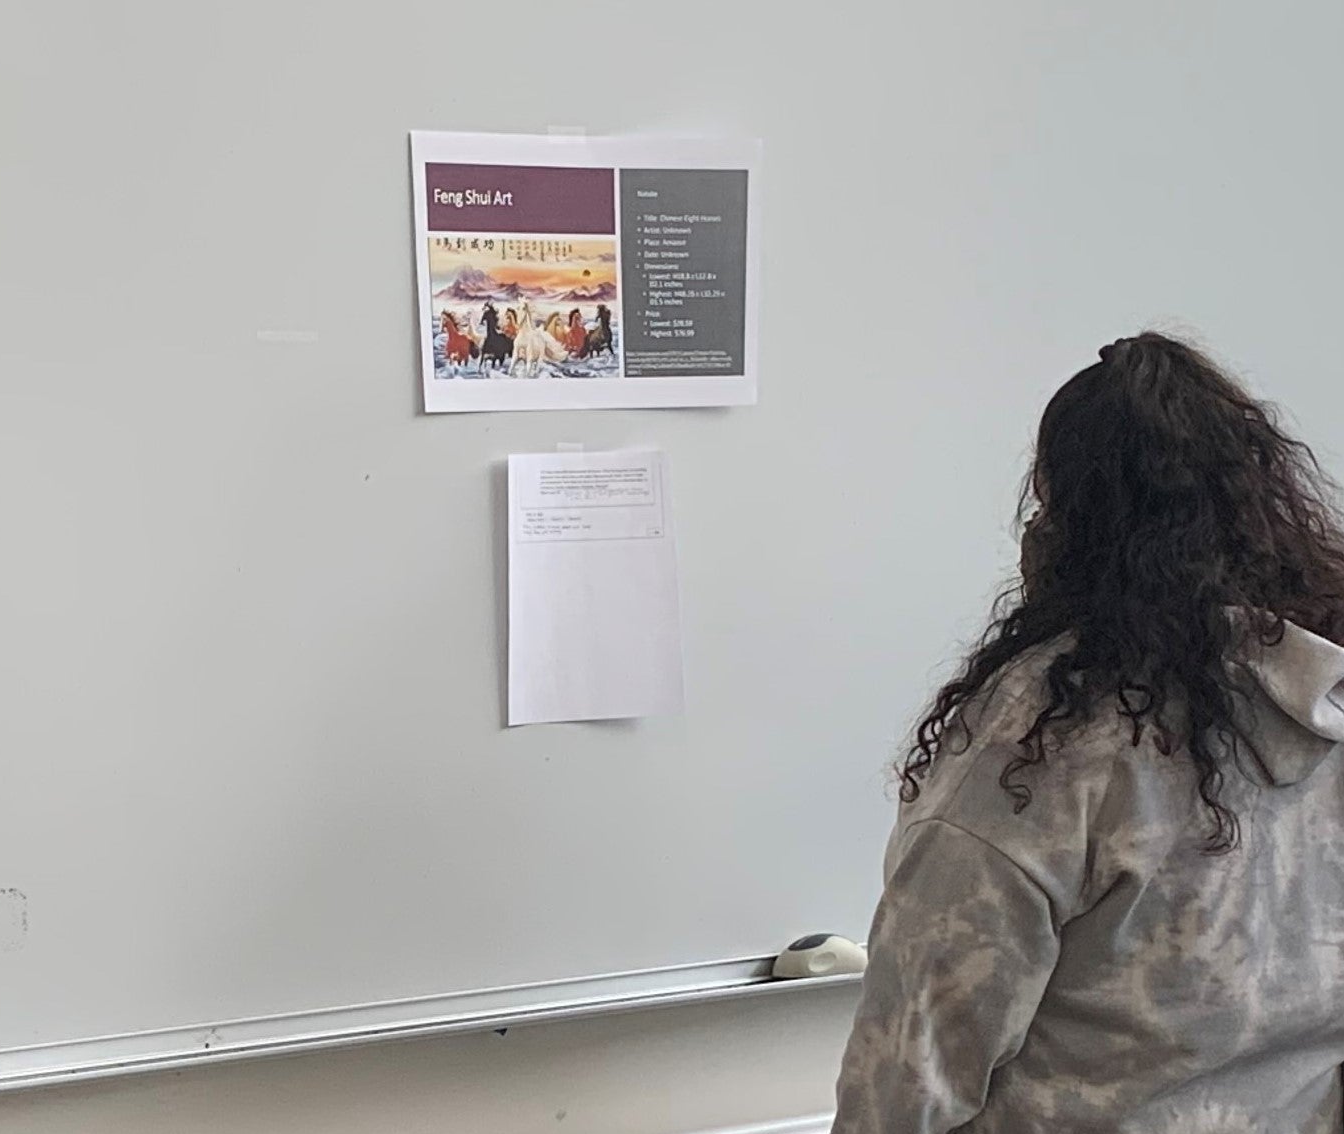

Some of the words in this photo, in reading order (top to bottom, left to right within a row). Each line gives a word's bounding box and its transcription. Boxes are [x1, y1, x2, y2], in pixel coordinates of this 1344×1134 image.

[434, 188, 463, 208] Feng
[465, 189, 491, 205] Shui
[493, 190, 514, 206] Art
